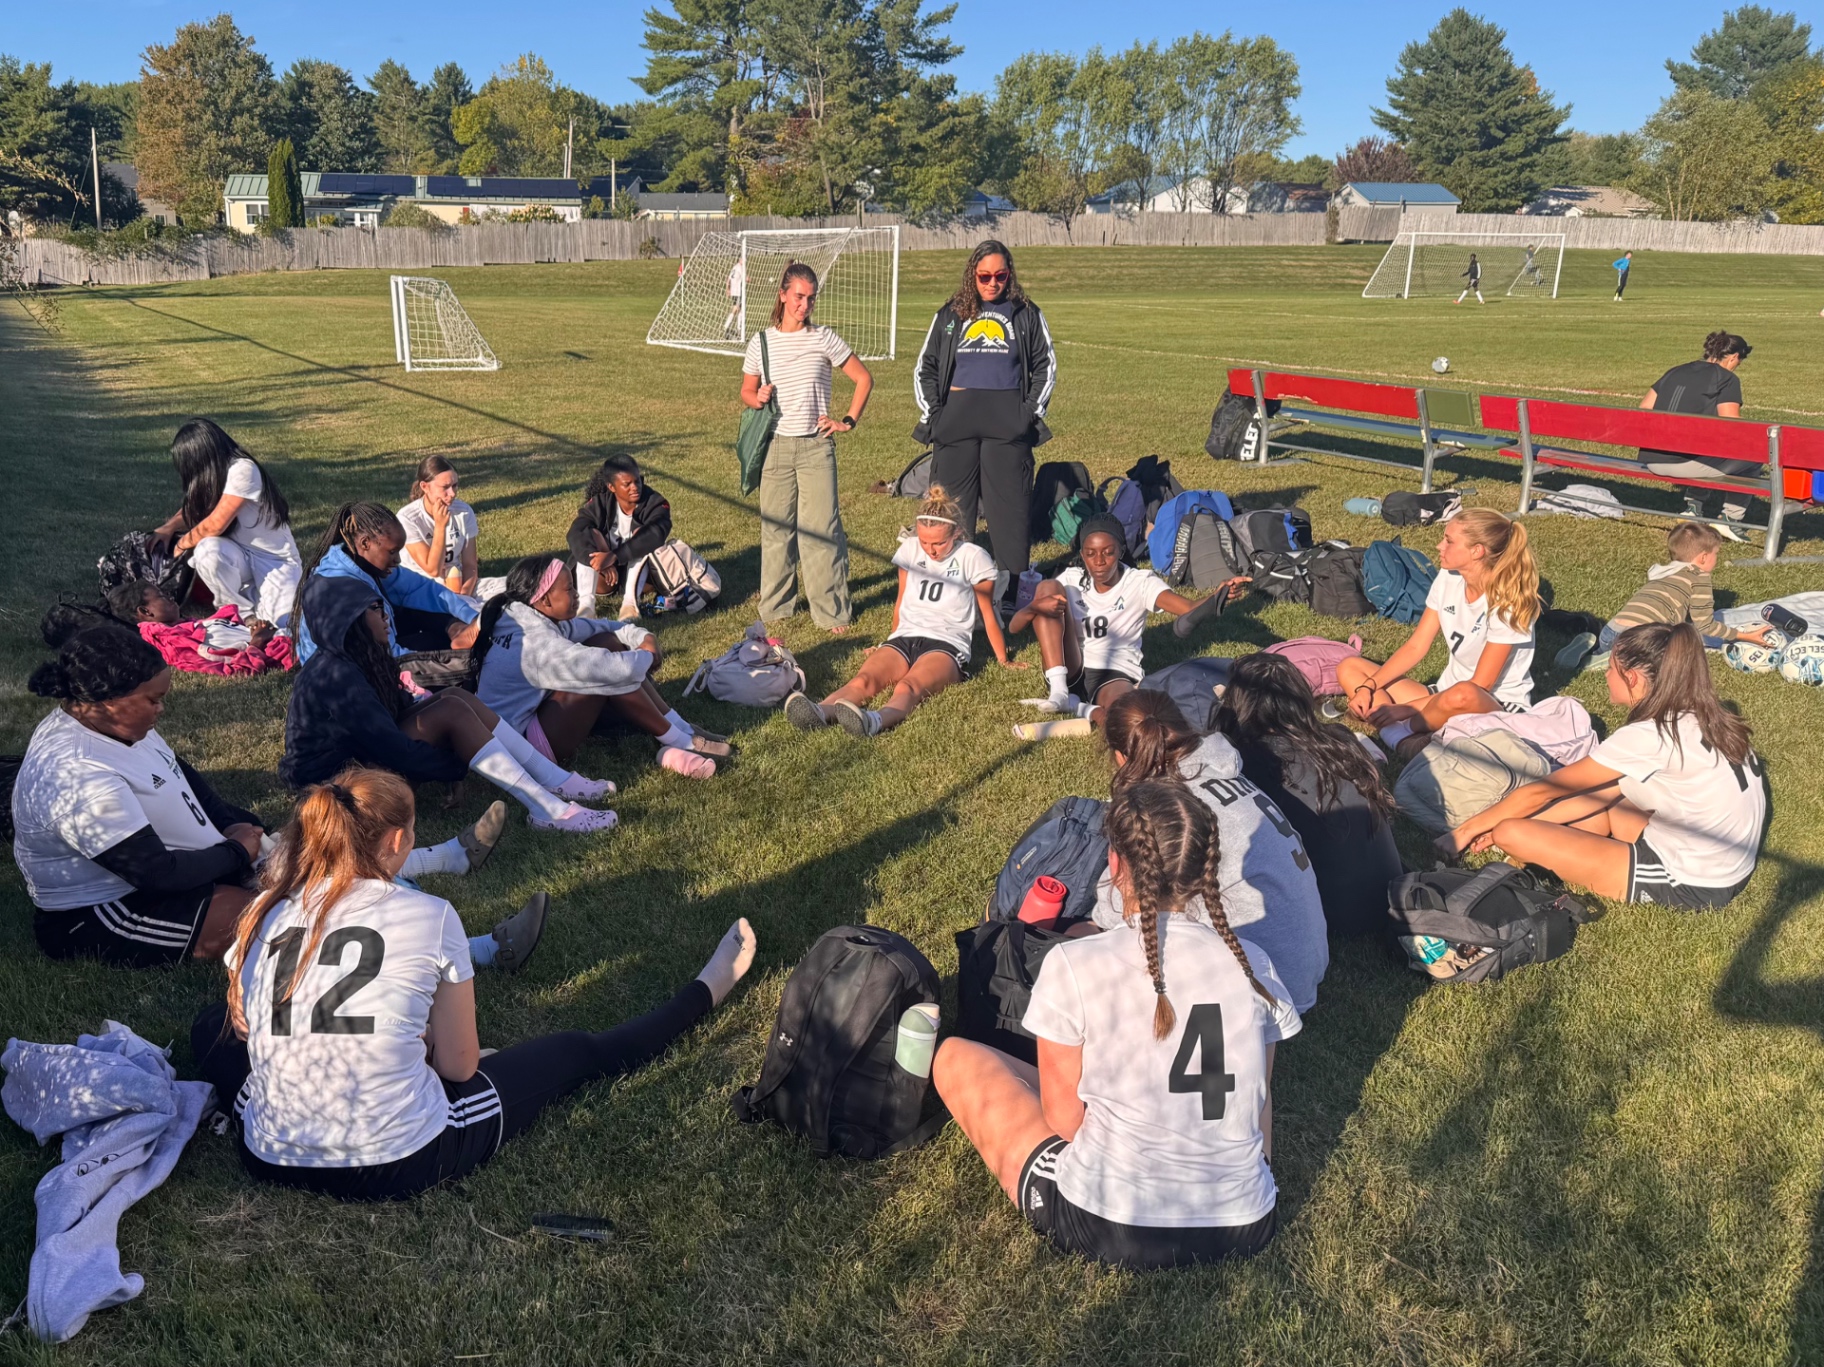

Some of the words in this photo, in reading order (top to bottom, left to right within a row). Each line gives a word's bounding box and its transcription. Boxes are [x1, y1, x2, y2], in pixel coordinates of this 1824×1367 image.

[918, 579, 944, 602] 10
[1081, 615, 1109, 639] 18
[1450, 631, 1465, 655] 7
[181, 790, 207, 827] 6
[267, 926, 386, 1036] 12
[1168, 1003, 1236, 1121] 4
